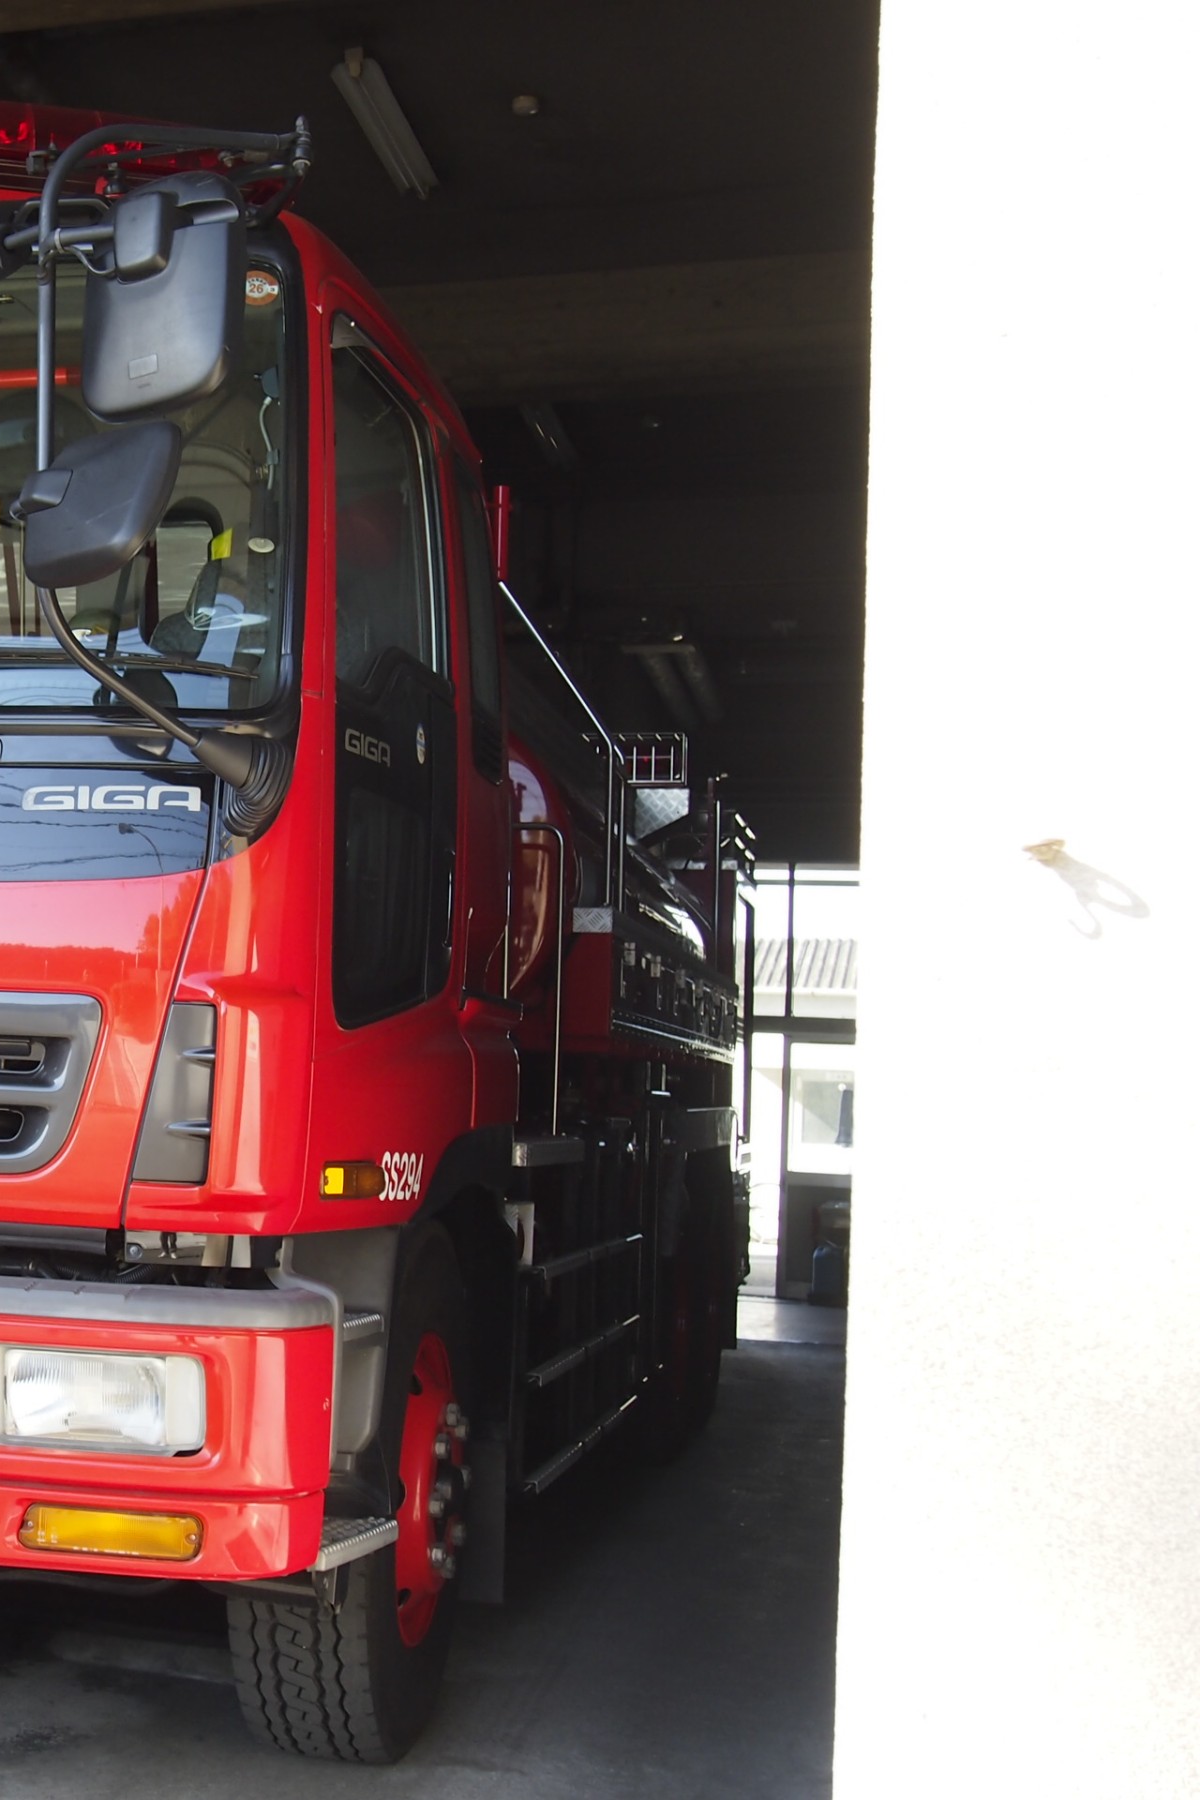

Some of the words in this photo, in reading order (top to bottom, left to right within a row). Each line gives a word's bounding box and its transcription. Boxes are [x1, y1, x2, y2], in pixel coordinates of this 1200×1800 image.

[249, 283, 264, 294] 26
[344, 728, 391, 768] GIGA
[22, 785, 201, 811] GIGA
[379, 1151, 424, 1201] SS294
